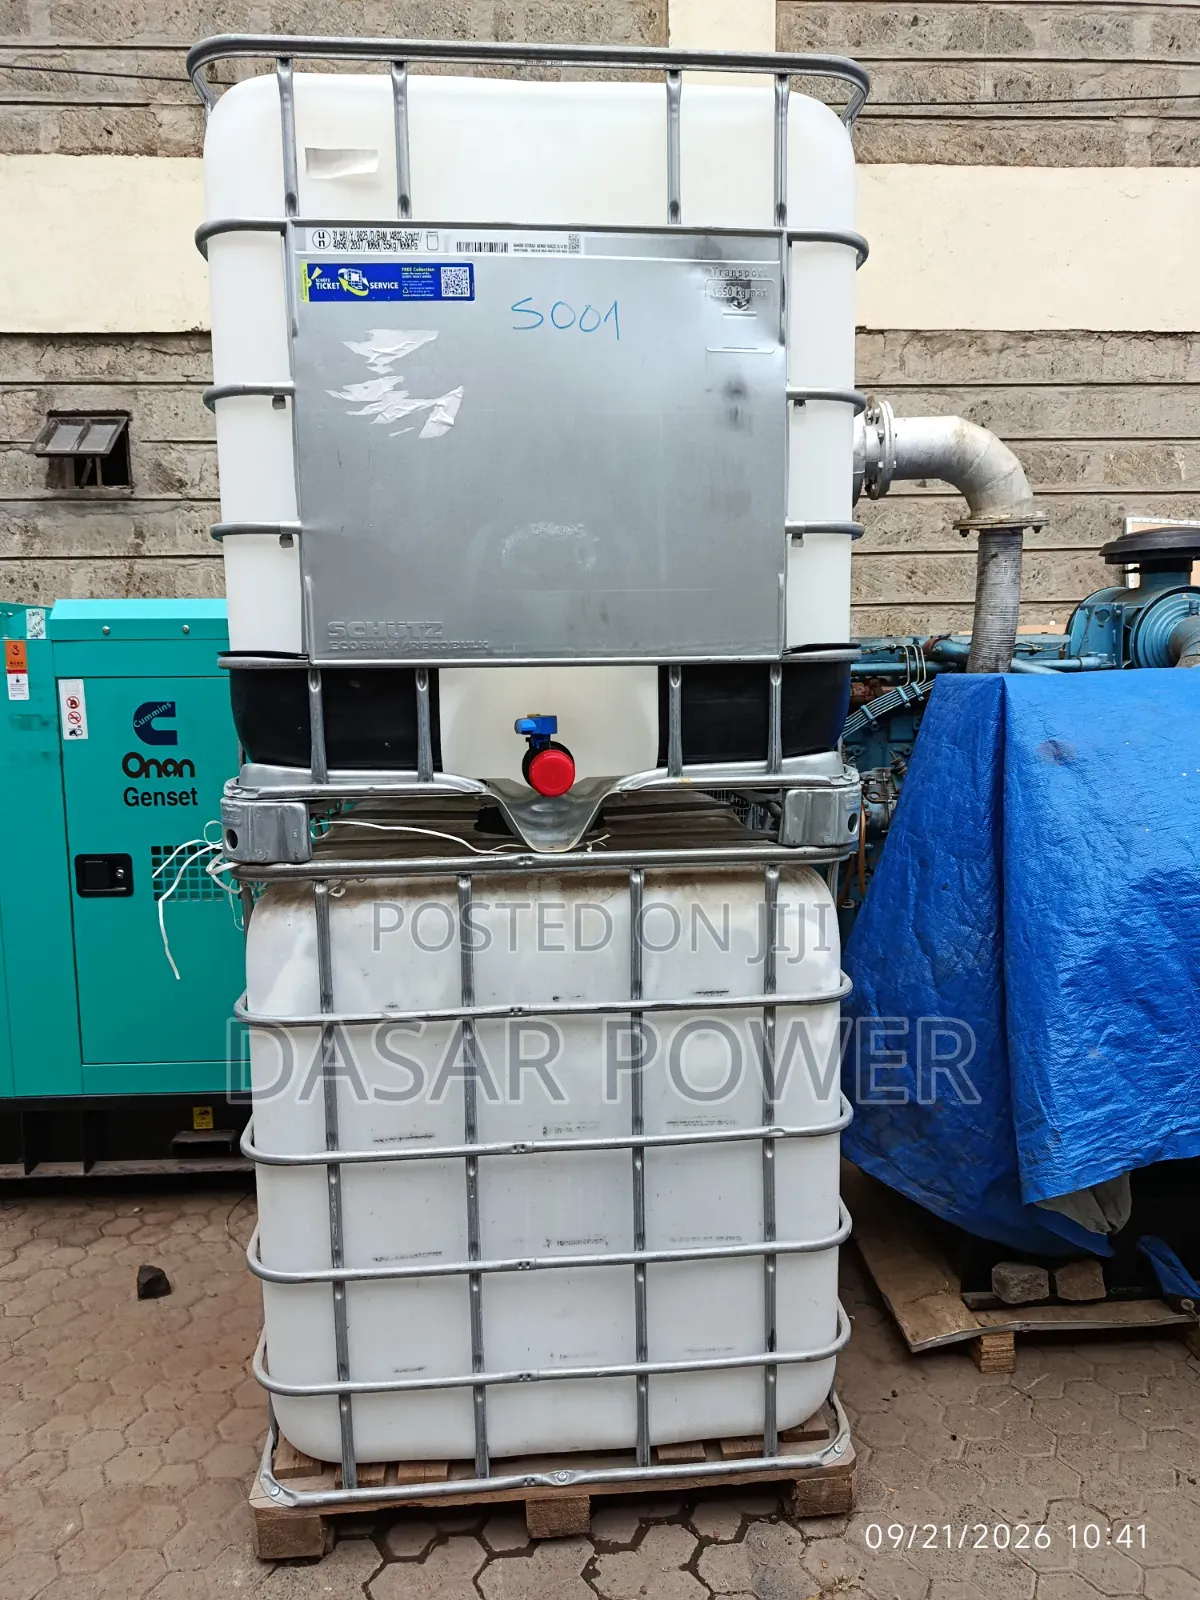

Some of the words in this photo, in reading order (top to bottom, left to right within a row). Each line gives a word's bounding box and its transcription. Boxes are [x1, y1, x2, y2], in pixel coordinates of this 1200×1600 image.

[316, 282, 340, 290] TICKET
[368, 281, 399, 290] SERVICE
[735, 286, 746, 299] kg
[327, 621, 443, 639] SCHÜTZ
[133, 701, 172, 728] Cummins
[122, 752, 195, 779] Onan
[123, 786, 198, 807] Genset
